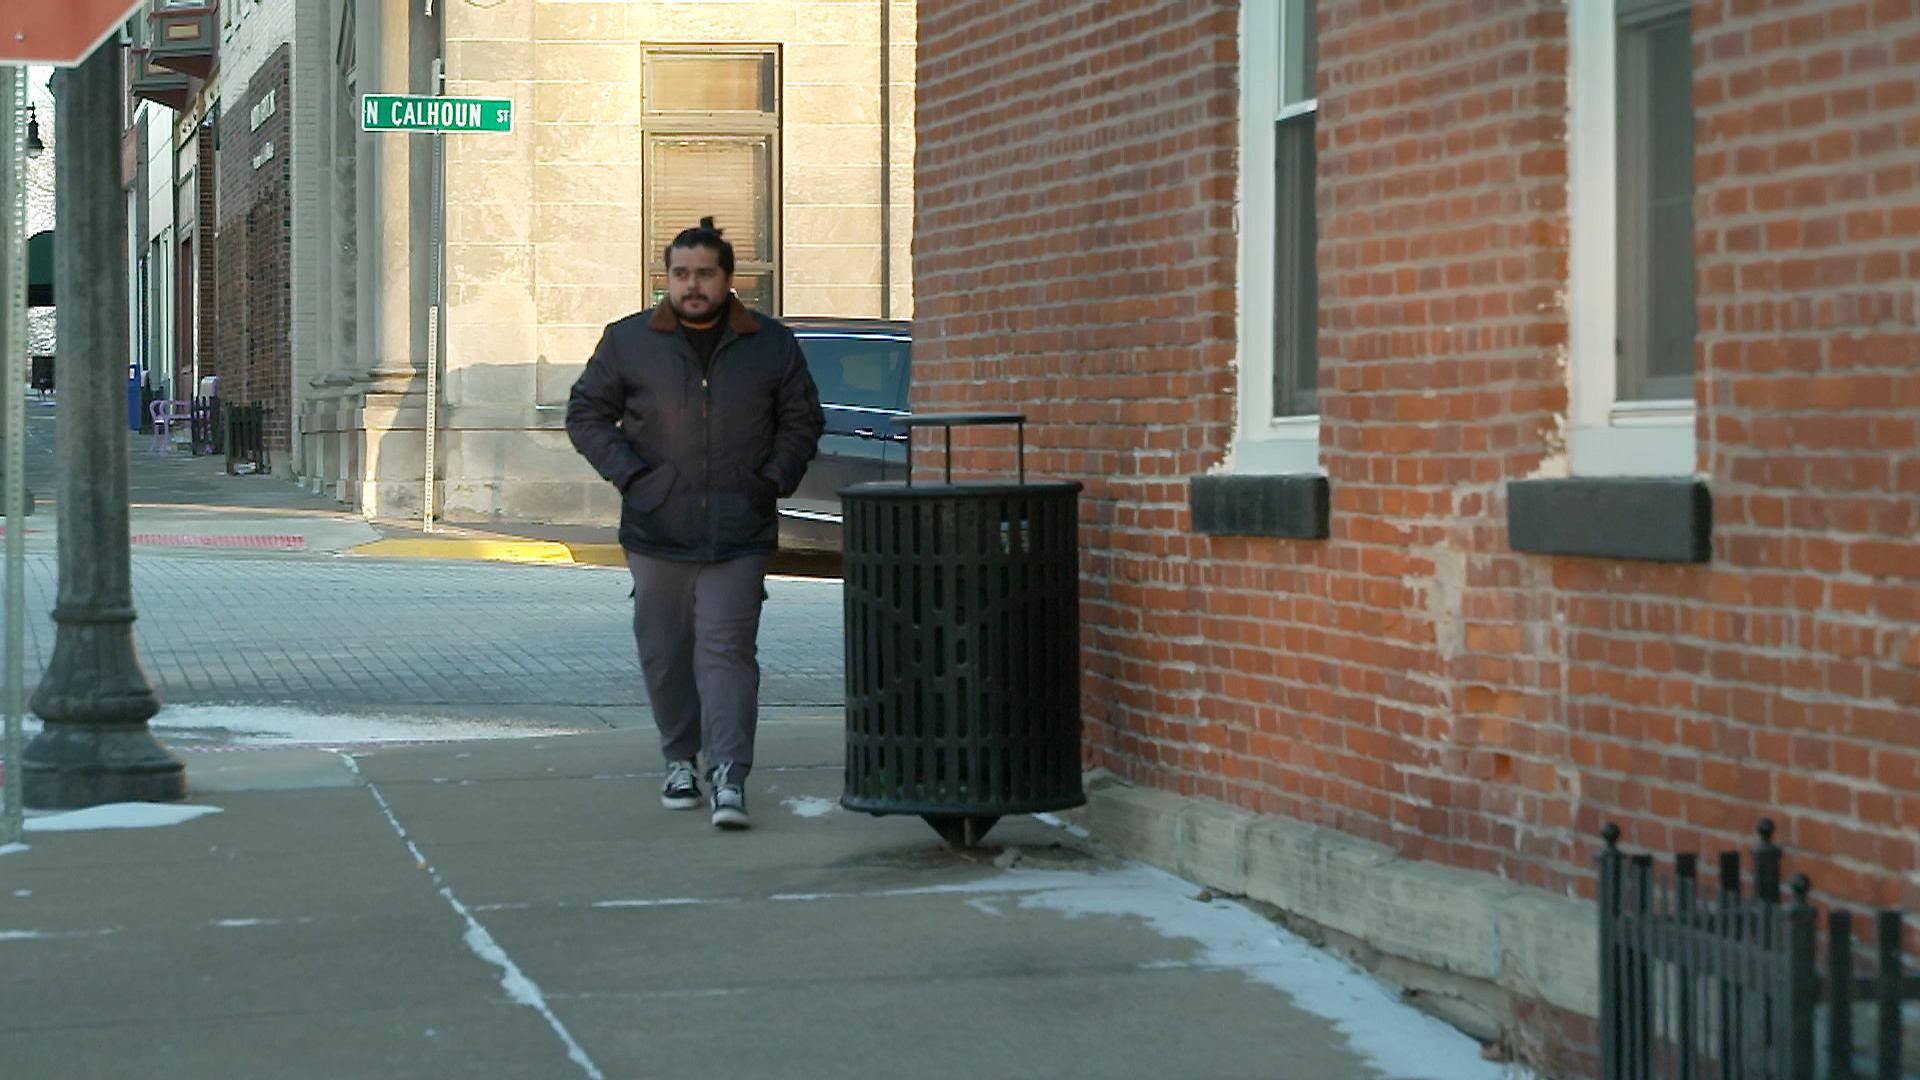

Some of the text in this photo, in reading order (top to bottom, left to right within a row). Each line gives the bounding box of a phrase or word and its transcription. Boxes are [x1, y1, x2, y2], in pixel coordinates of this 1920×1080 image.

[366, 101, 509, 127] N CALHOUN ST
